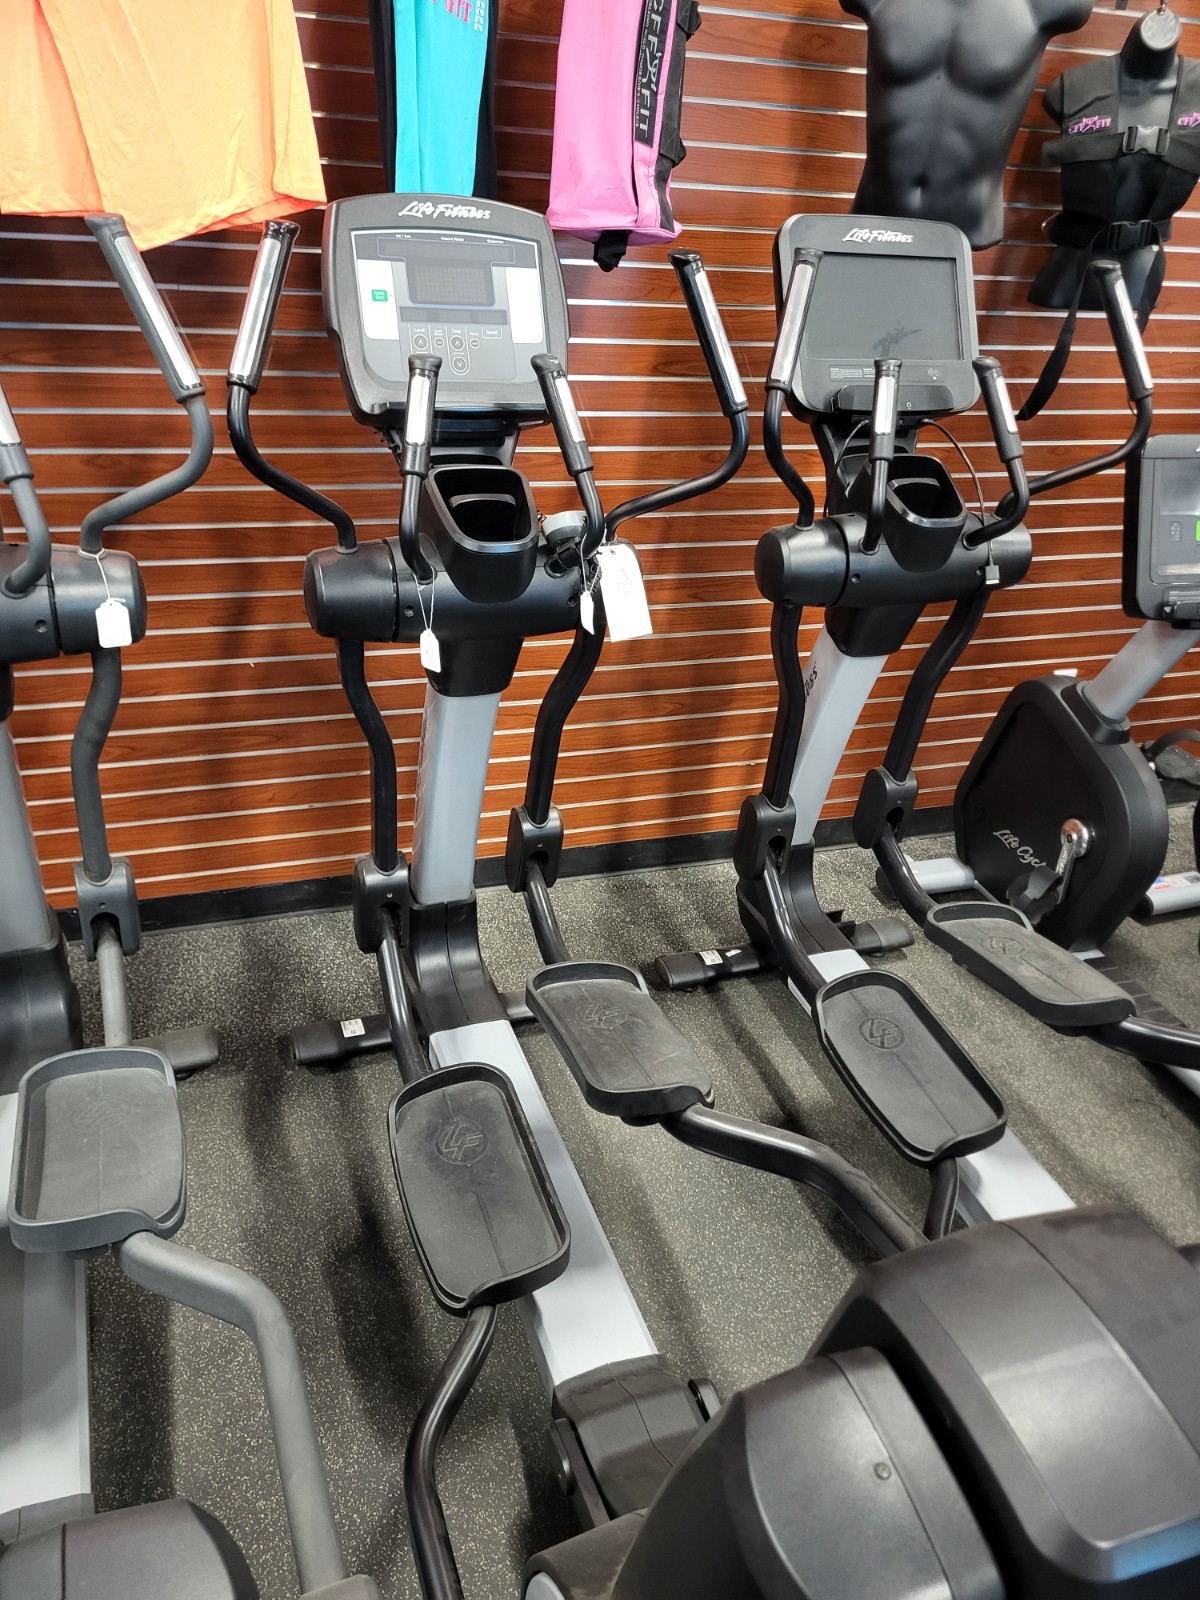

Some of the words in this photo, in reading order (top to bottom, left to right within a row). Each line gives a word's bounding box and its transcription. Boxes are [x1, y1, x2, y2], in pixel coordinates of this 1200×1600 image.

[640, 88, 651, 138] FIT
[398, 200, 435, 219] Life
[432, 203, 492, 220] Fitness
[842, 227, 871, 243] Life
[867, 229, 914, 244] Fitness
[993, 829, 1020, 849] Life
[1016, 846, 1047, 868] Cycl
